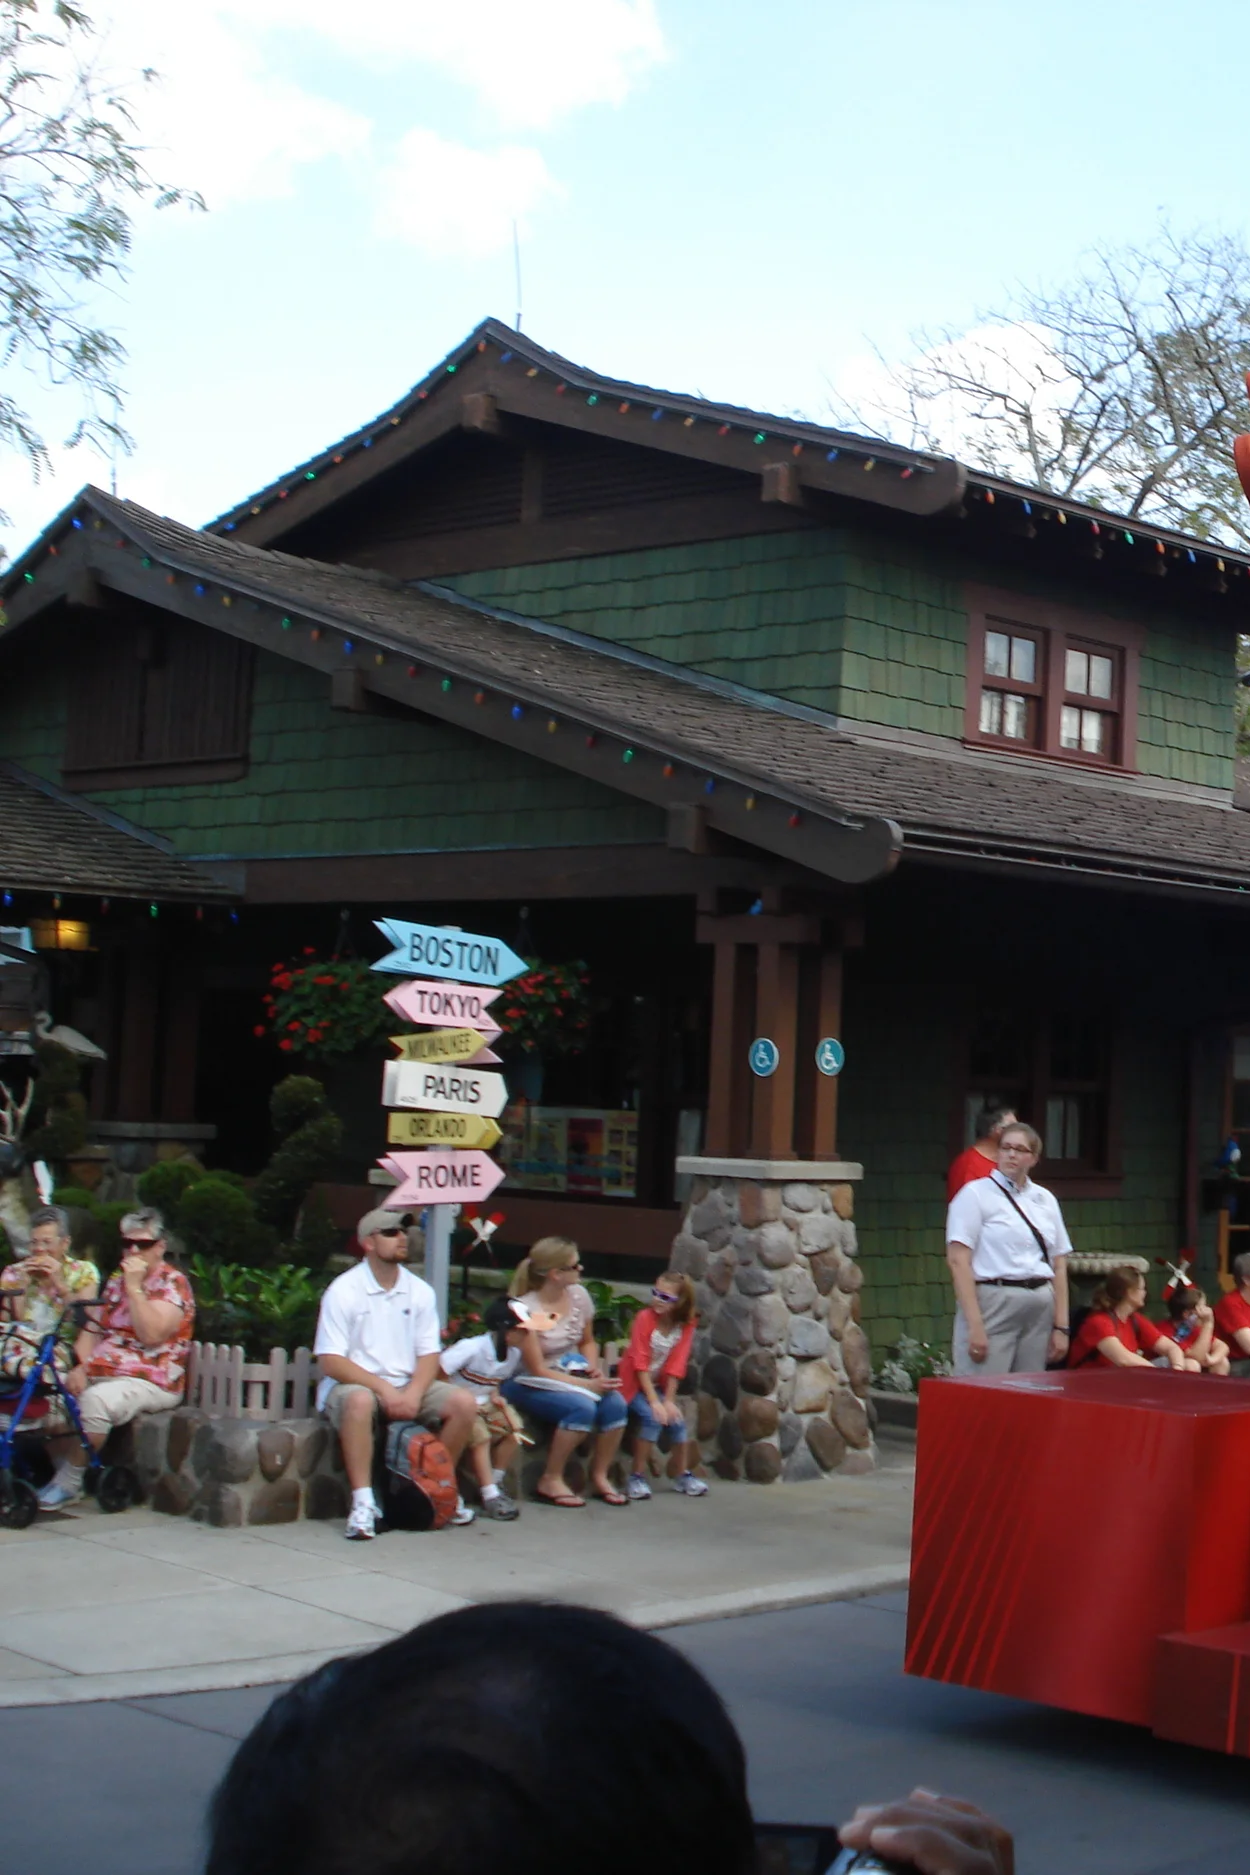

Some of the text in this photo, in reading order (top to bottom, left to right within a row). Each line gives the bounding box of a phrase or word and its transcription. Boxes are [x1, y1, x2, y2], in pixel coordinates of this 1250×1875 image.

[409, 932, 500, 977] BOSTON
[416, 988, 482, 1019] TOKYO
[407, 1032, 472, 1059] MILWAUKEE
[423, 1074, 481, 1104] PARIS
[408, 1117, 467, 1138] ORLANDO
[417, 1163, 482, 1189] ROME
